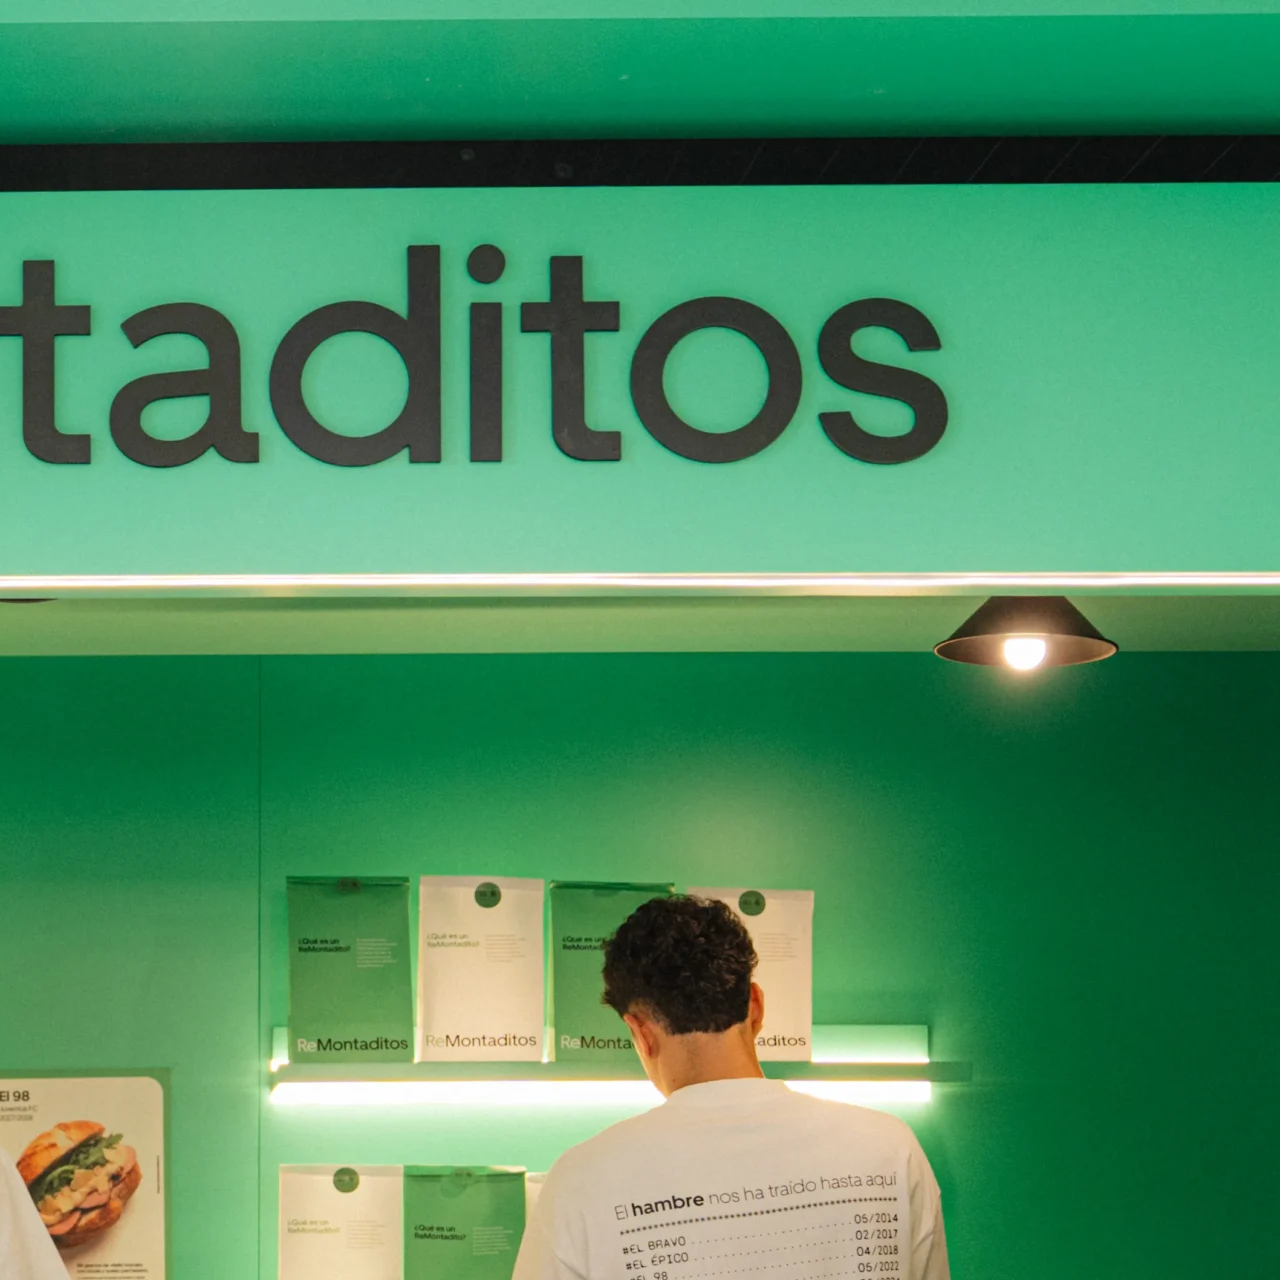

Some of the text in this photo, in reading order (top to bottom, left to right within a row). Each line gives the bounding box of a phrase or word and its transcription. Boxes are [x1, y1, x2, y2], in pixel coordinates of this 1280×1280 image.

[297, 1036, 409, 1053] ReMontaditos
[426, 1033, 537, 1048] ReMontaditos
[561, 1035, 636, 1050] ReMonta
[754, 1034, 807, 1047] aditos
[0, 1090, 30, 1102] El 98
[614, 1172, 897, 1221] El hambre nos ha traído hasta aquí
[622, 1213, 898, 1255] #EL BRAVO 05/2014
[626, 1229, 898, 1270] #EL ÉPICO 02/2017
[856, 1245, 899, 1256] 04/2018
[857, 1261, 899, 1273] 05/2022
